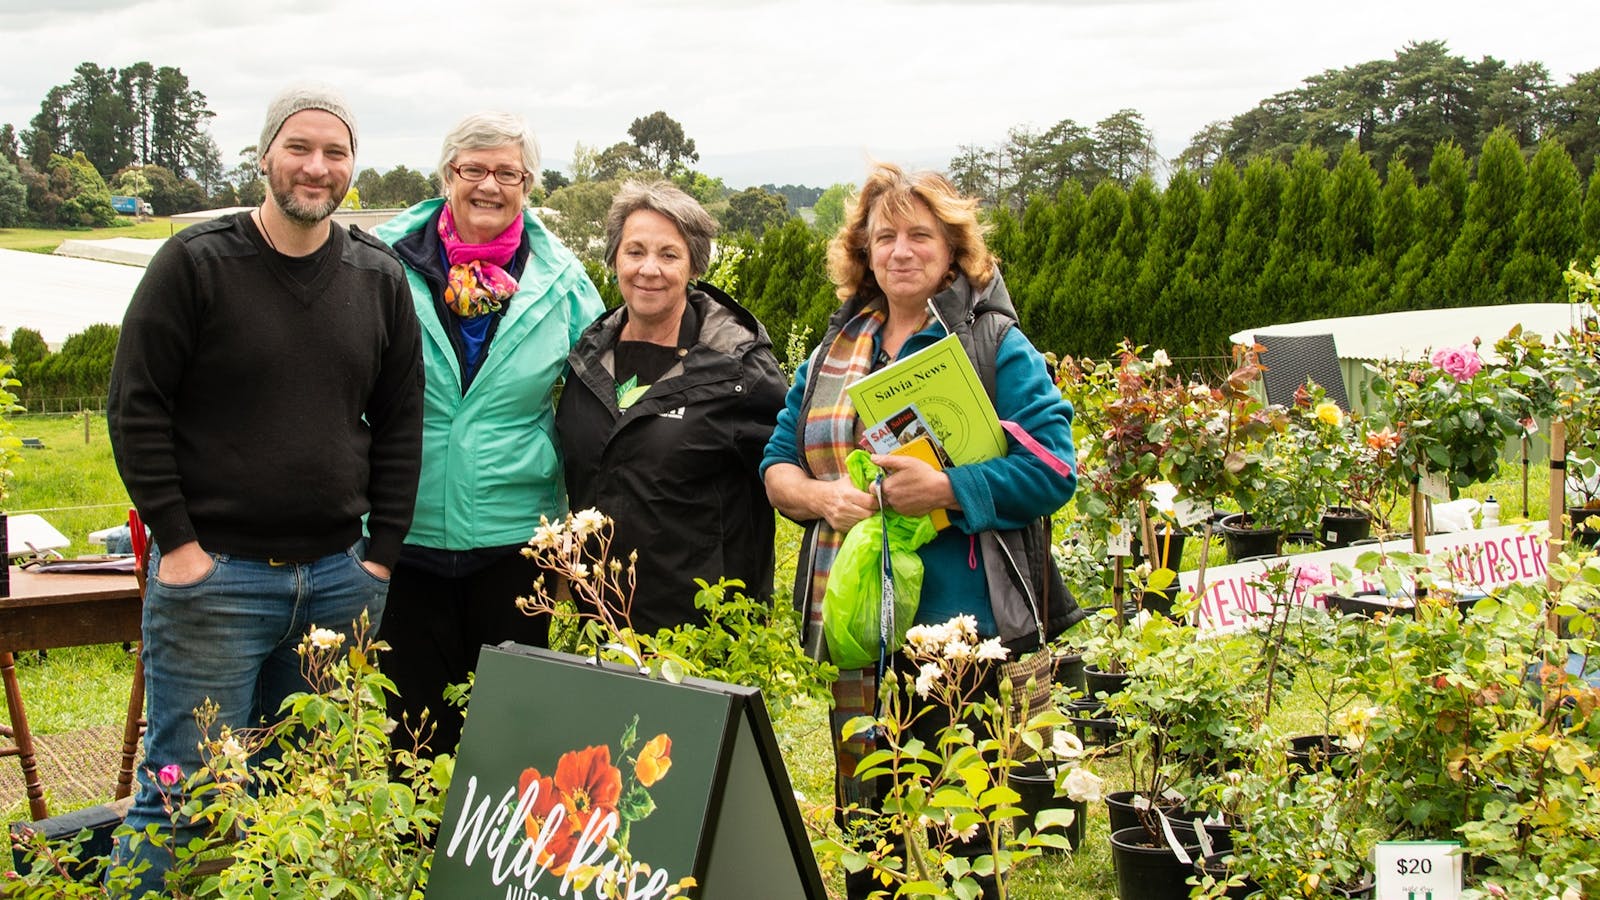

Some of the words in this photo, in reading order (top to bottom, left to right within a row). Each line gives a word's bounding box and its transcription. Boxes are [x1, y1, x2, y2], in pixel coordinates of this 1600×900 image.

[875, 380, 912, 402] Salvia
[914, 363, 947, 383] News
[1443, 534, 1549, 587] NURSER
[447, 776, 563, 890] Wild
[559, 807, 669, 900] Rose
[1397, 858, 1432, 875] $20
